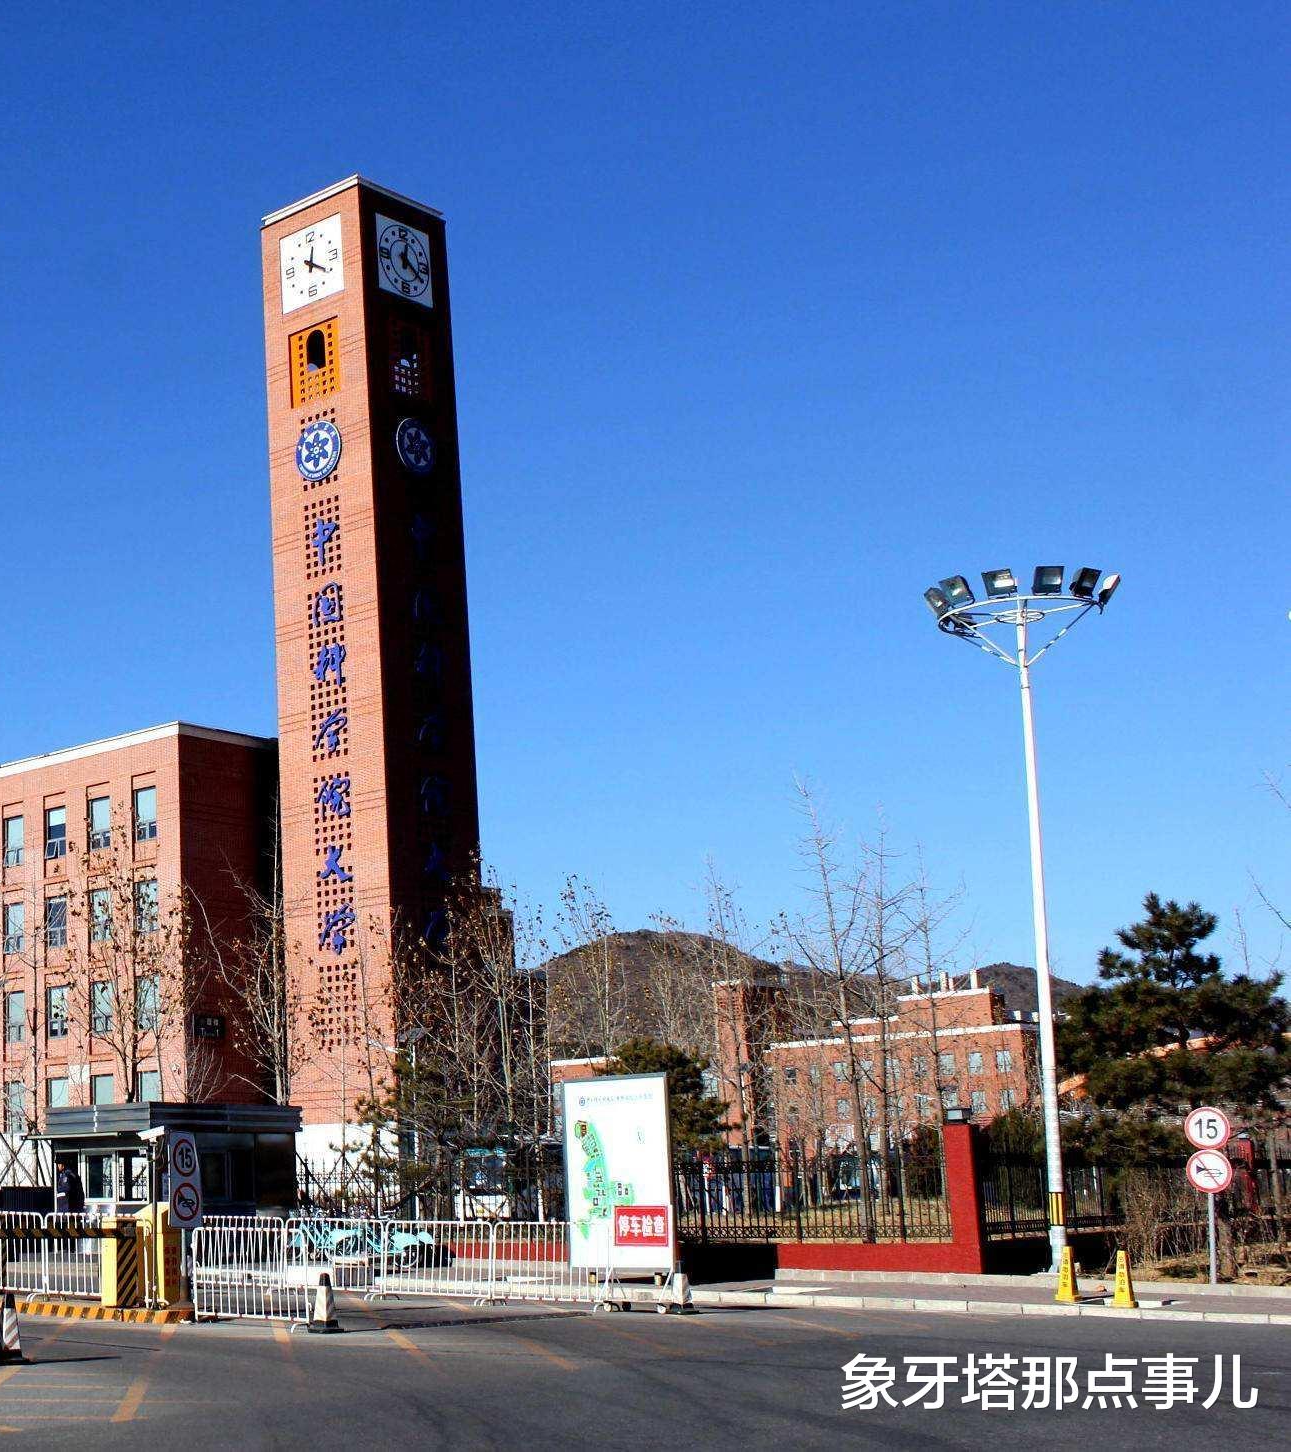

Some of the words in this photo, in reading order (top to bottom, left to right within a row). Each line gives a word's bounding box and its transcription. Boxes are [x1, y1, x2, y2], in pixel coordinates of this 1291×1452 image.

[306, 231, 315, 244] 12
[328, 248, 338, 261] 3
[286, 267, 295, 279] 9
[309, 285, 318, 297] 6
[311, 518, 355, 956] 中国科学院大学
[1194, 1118, 1218, 1139] 15
[178, 1147, 193, 1169] 15
[618, 1214, 667, 1238] 停车检查
